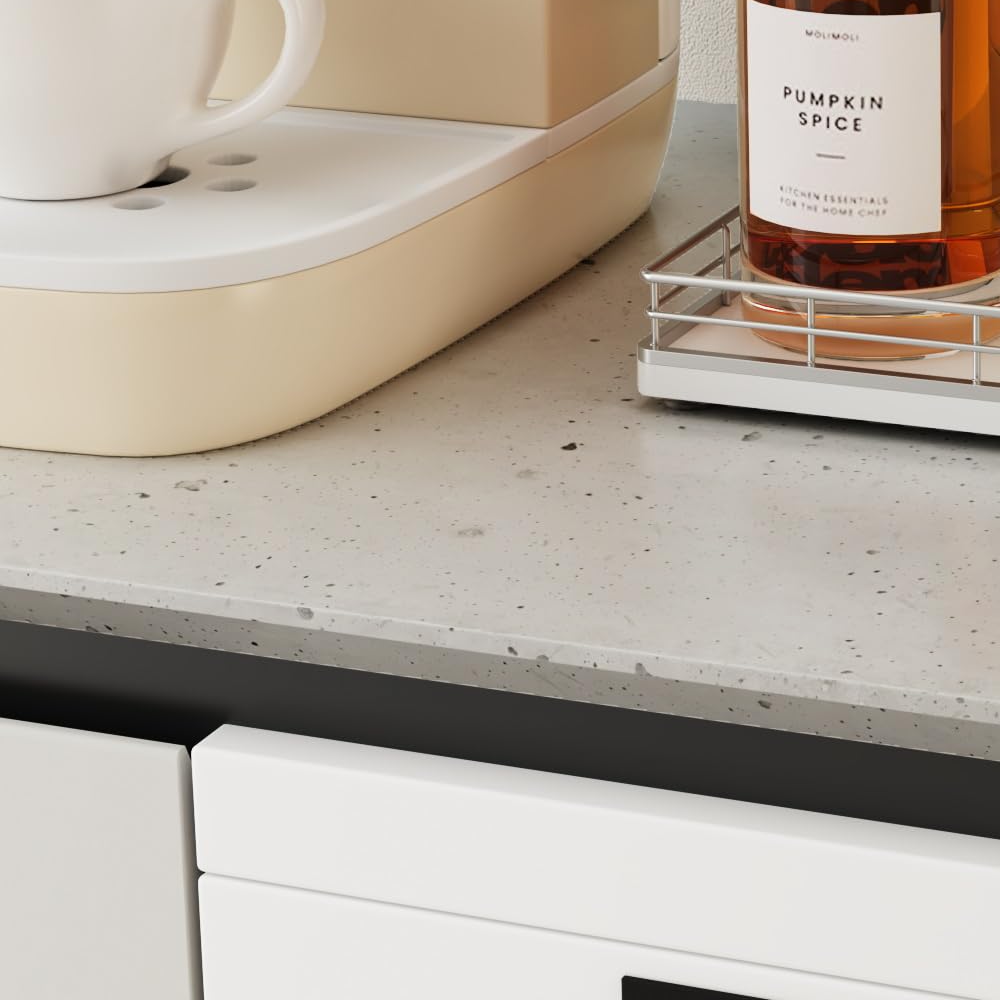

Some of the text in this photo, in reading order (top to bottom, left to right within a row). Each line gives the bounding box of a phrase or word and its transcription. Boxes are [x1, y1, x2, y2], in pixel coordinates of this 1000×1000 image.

[805, 29, 859, 41] MOLIMOLI
[783, 86, 884, 110] PUMPKIN
[798, 111, 862, 133] SPICE
[779, 185, 889, 206] KITCHEN ESSENTIALS
[780, 197, 887, 218] FOR THE HOME CHEF
